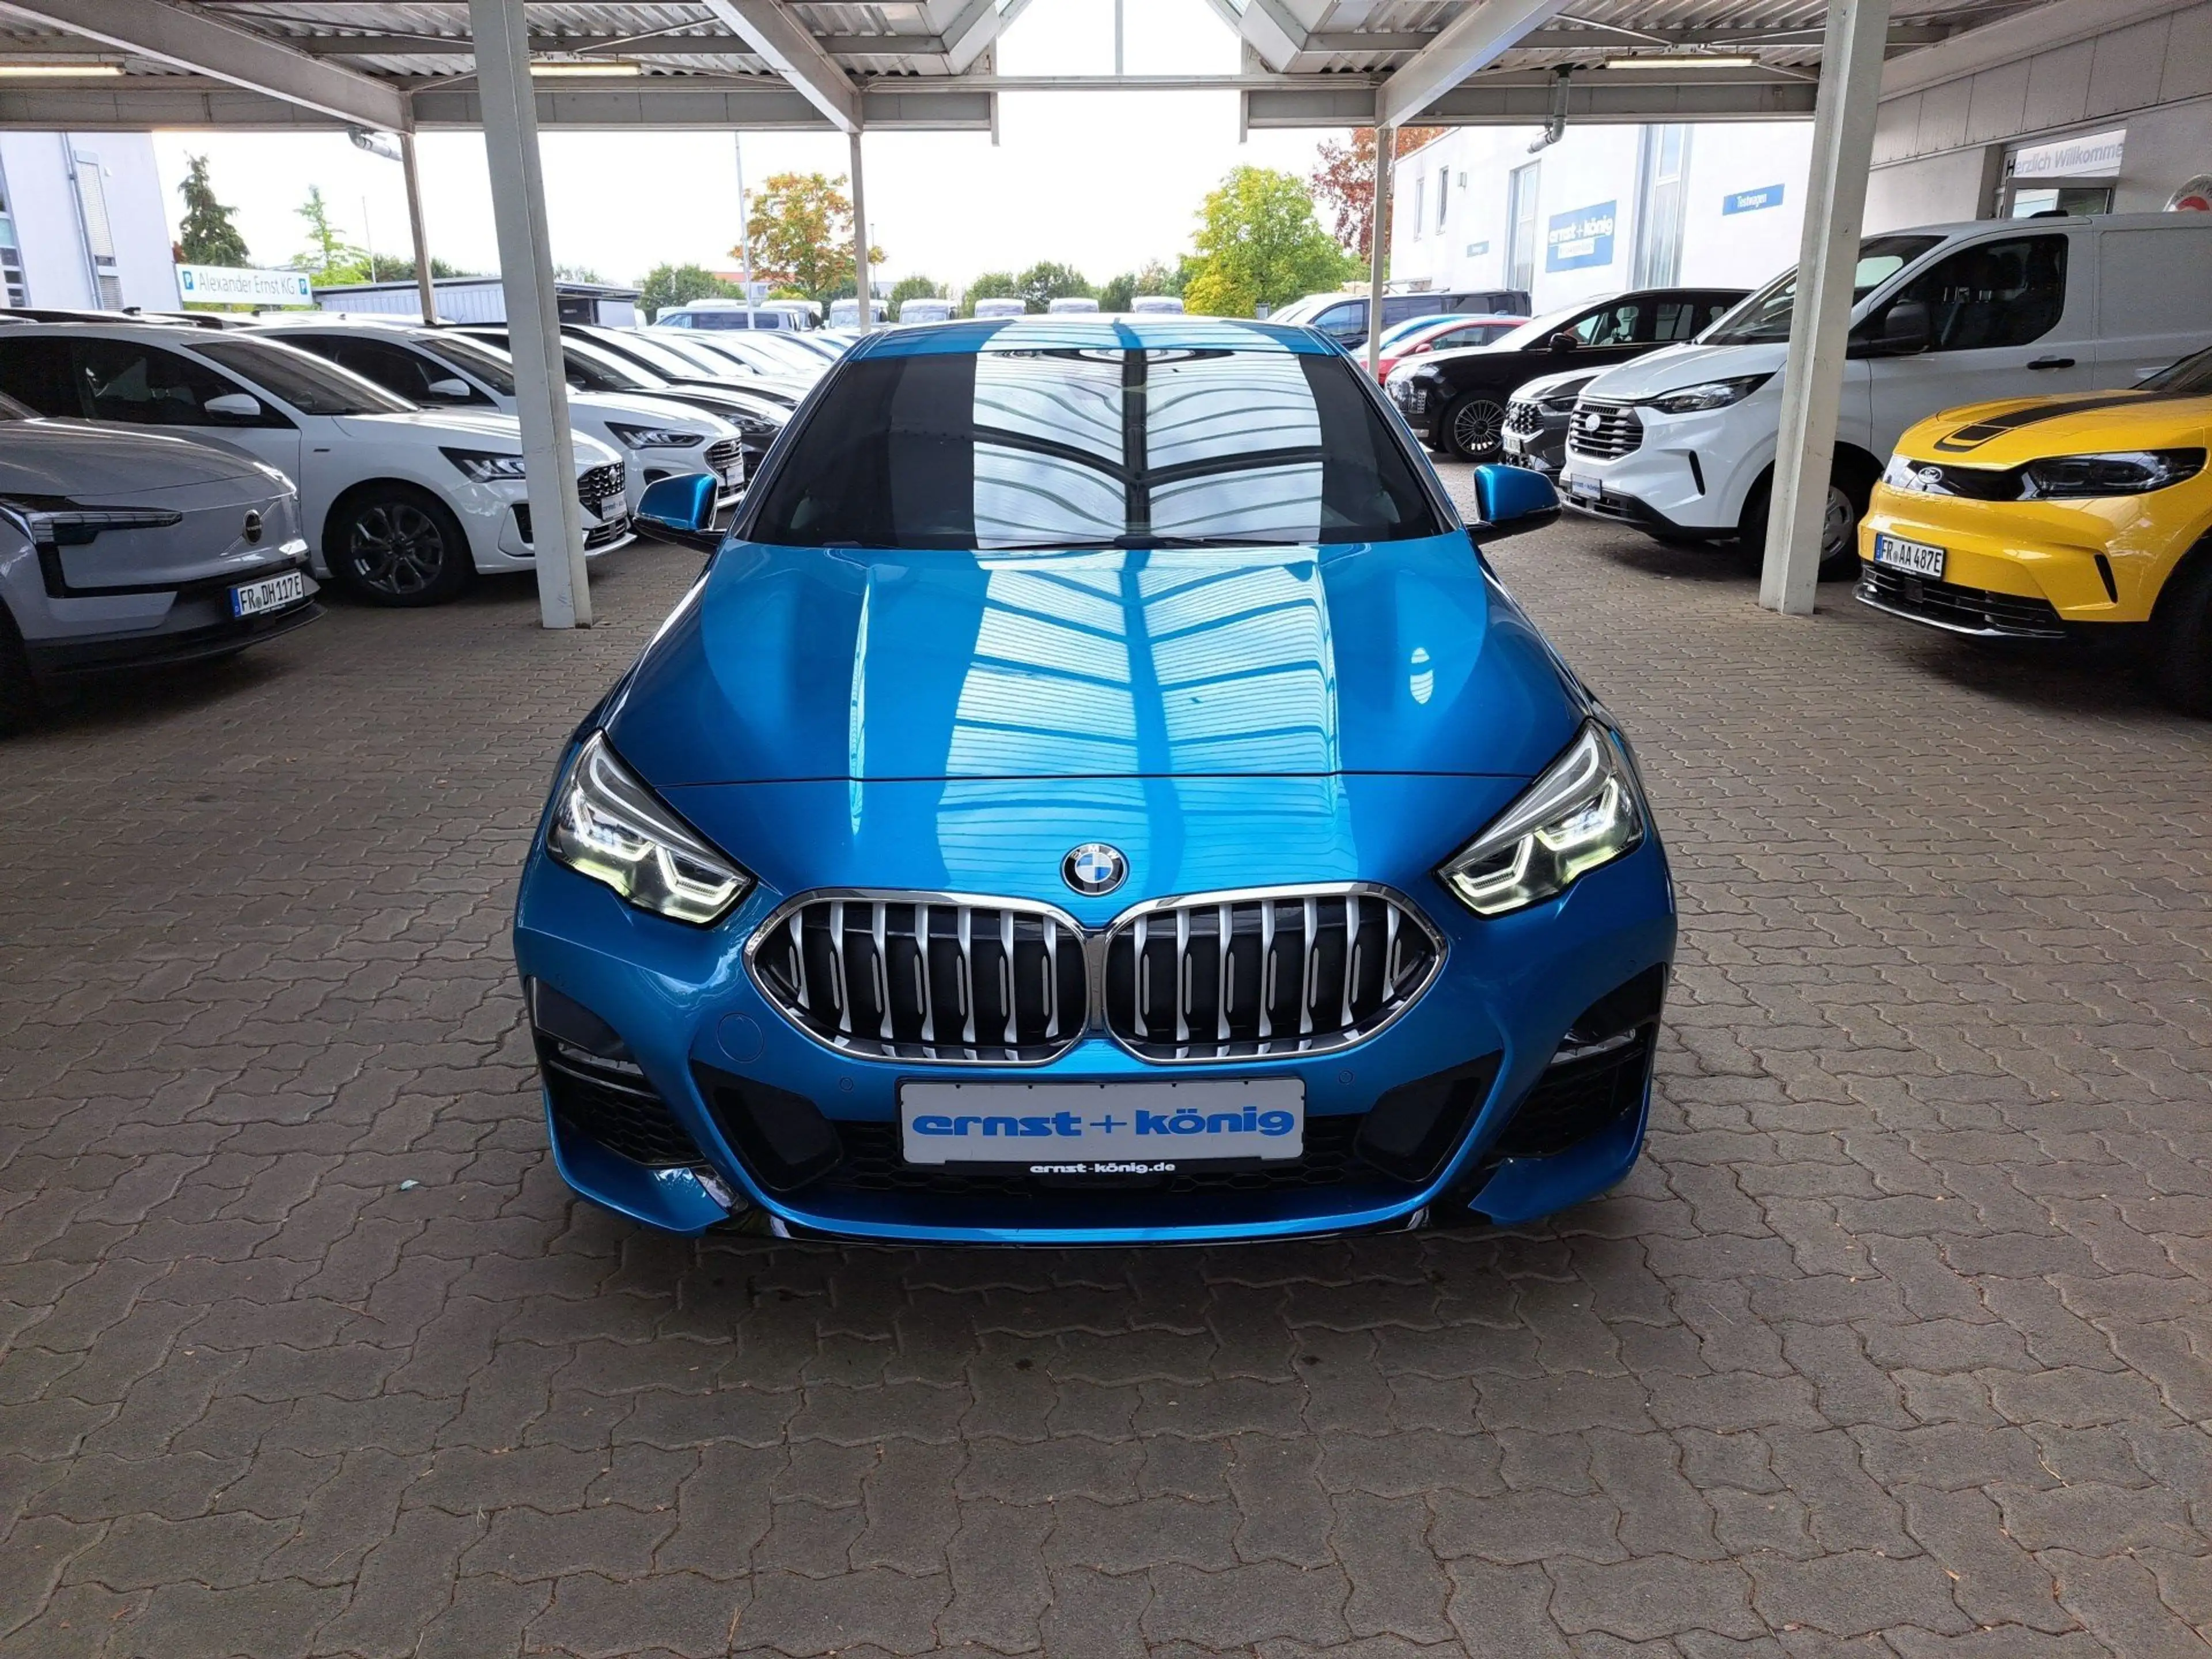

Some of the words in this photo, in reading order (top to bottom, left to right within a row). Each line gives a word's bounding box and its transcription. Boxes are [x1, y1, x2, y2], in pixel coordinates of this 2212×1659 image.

[2006, 151, 2051, 176] Herzlich
[2055, 143, 2124, 168] Willkomme
[1550, 222, 1577, 244] ernst
[1584, 214, 1613, 236] könig
[199, 272, 252, 293] Alexander
[254, 275, 278, 294] Ernst
[281, 277, 295, 295] KG
[1914, 548, 1942, 573] 487E
[1071, 845, 1120, 861] BMW
[912, 1111, 1082, 1137] ernst
[1089, 1115, 1127, 1134] +
[1135, 1105, 1295, 1137] könig
[1030, 1162, 1176, 1174] ernst-könig.de
